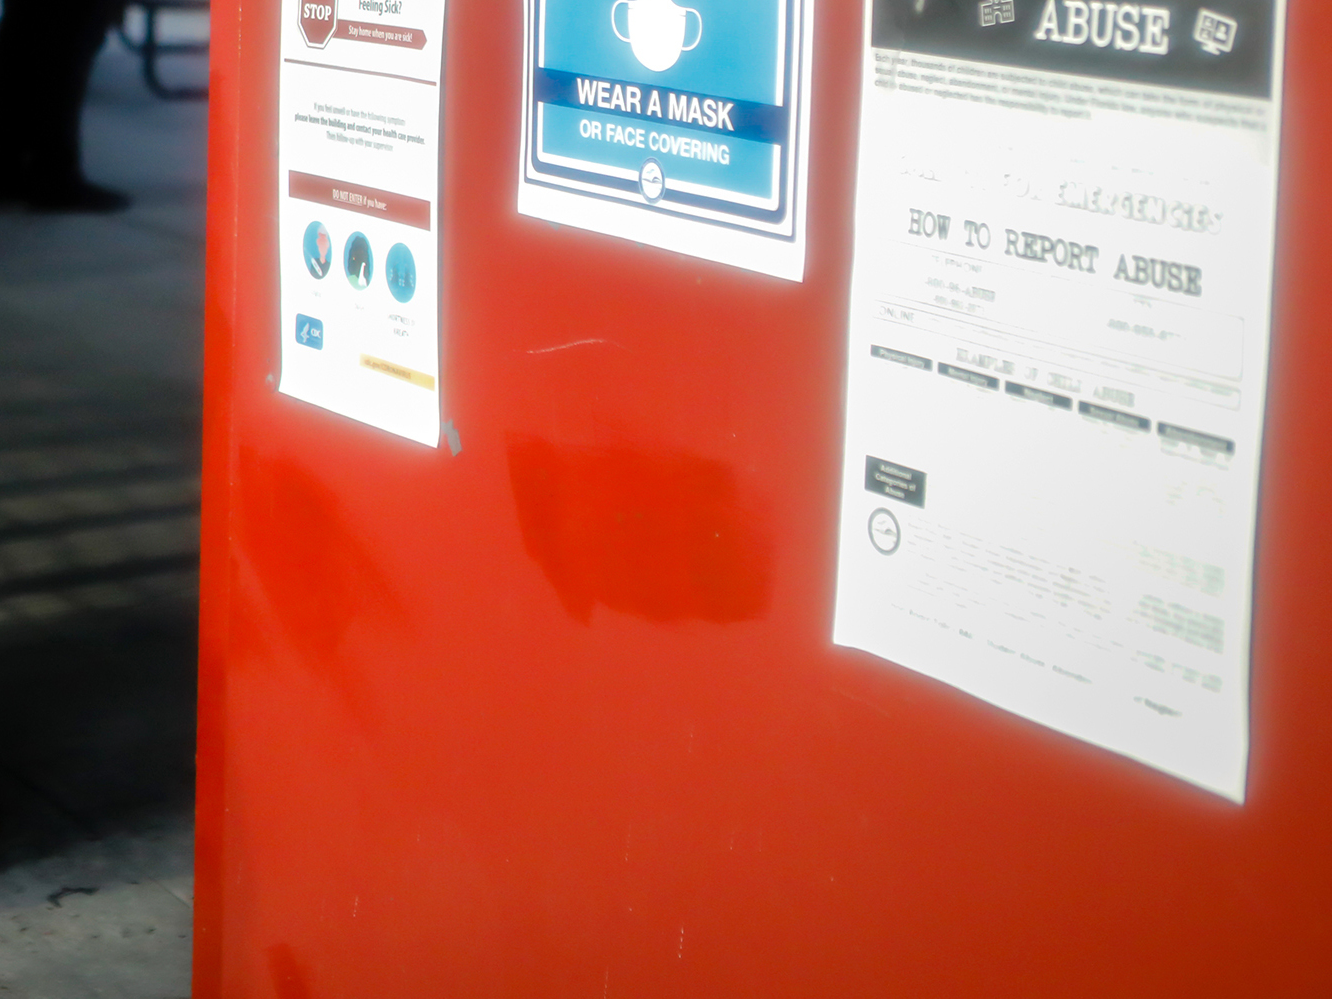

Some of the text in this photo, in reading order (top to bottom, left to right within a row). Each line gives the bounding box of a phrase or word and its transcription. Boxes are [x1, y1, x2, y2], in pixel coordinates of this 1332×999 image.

[304, 3, 332, 21] STOP
[384, 0, 402, 14] Sick?
[349, 25, 358, 37] Stay
[359, 26, 371, 37] home
[372, 29, 384, 38] when
[385, 33, 393, 41] you
[577, 78, 734, 131] WEAR A MASK
[580, 120, 730, 165] OR FACE COVERING
[333, 189, 339, 198] DO
[340, 191, 348, 201] NOT
[349, 192, 362, 204] ENTER
[908, 207, 1202, 297] HOW TO REPORT ABUSE
